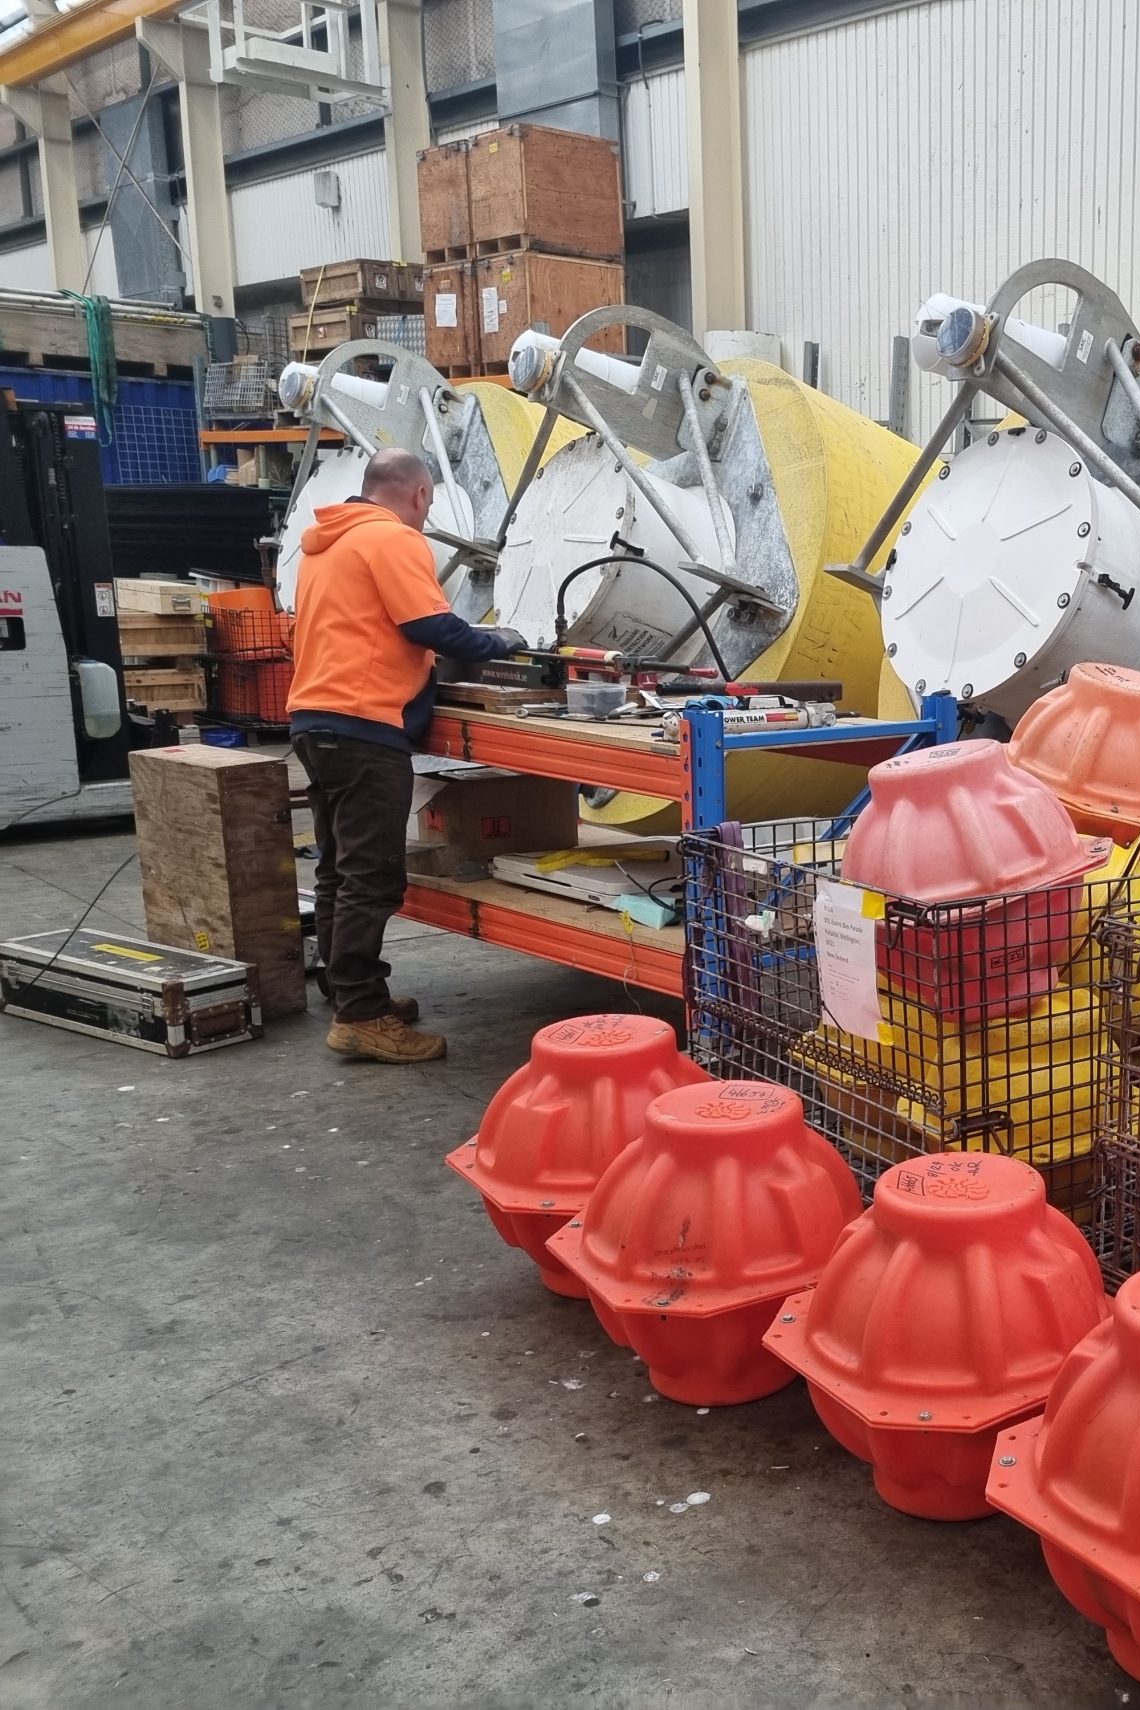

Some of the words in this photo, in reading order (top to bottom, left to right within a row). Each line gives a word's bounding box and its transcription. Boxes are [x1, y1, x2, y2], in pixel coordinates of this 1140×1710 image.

[619, 628, 641, 648] TSUNAMI
[482, 669, 528, 682] www.wireteknik.se
[723, 715, 746, 724] OWER
[746, 715, 765, 723] TEAM
[831, 918, 842, 928] Evans
[842, 921, 850, 930] Bay
[850, 924, 863, 934] Parade
